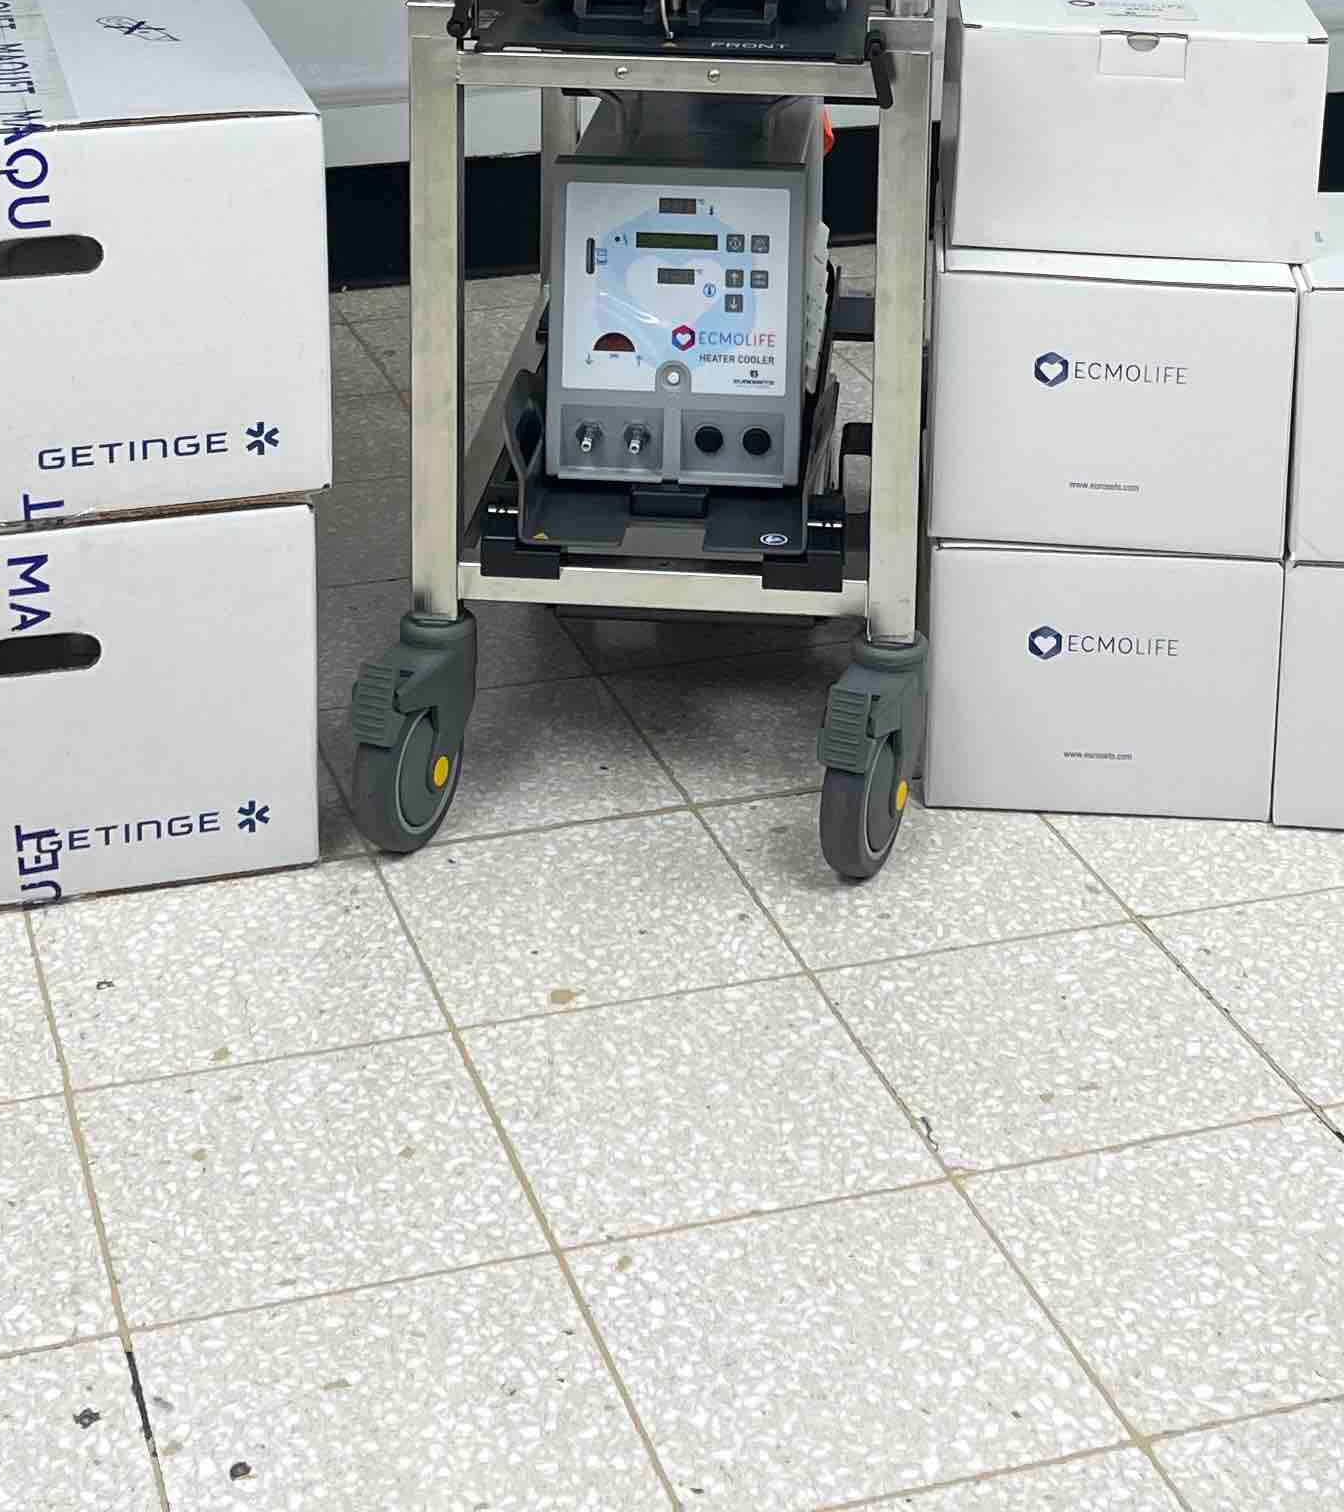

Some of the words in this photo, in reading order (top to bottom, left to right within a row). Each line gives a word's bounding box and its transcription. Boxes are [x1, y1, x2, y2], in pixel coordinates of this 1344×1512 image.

[710, 40, 790, 49] FRONT
[698, 330, 777, 348] ECMOLIFE
[699, 353, 735, 364] HEATER
[737, 354, 775, 365] COOLER
[1074, 361, 1189, 385] ECMOLIFE
[38, 432, 229, 470] GETINGE
[1068, 634, 1180, 657] ECMOLIFE
[36, 811, 222, 855] GETINGE
